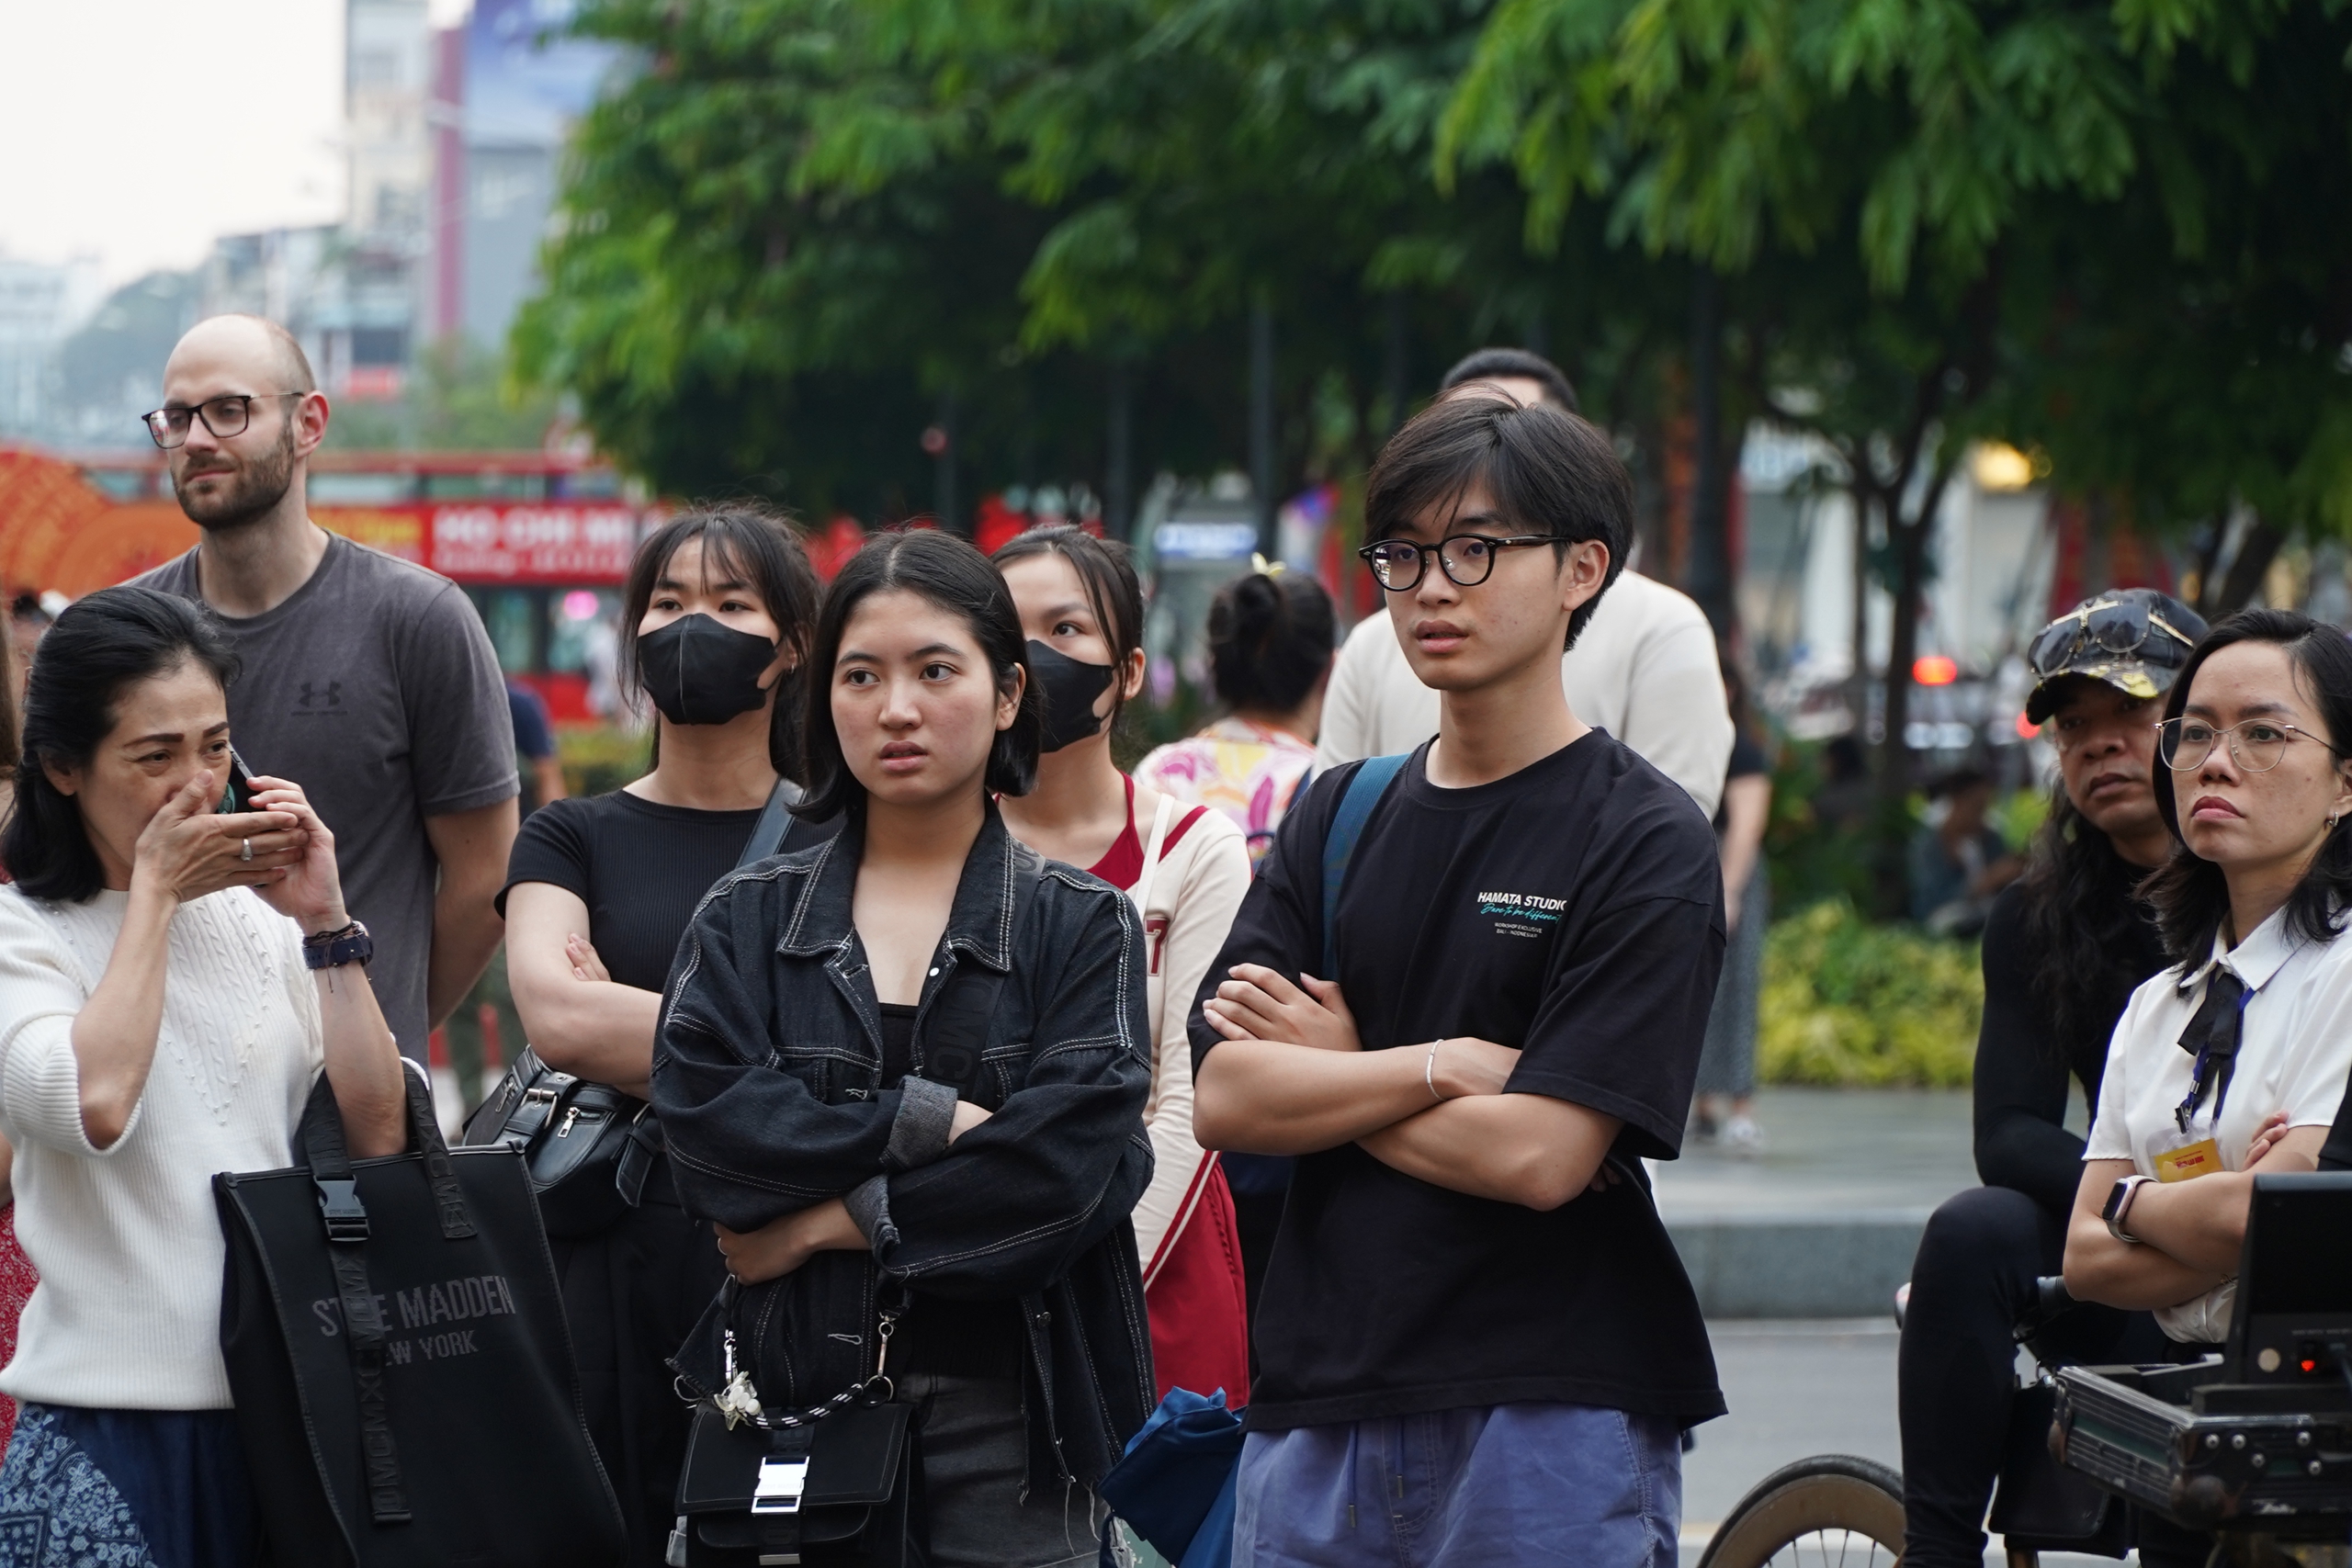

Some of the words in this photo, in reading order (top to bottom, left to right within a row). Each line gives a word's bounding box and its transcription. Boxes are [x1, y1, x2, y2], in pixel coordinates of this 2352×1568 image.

[1477, 892, 1521, 905] HAMATA
[1145, 917, 1170, 977] 7
[311, 1293, 394, 1337] STE
[396, 1275, 516, 1330] MADDEN
[418, 1329, 480, 1360] YORK
